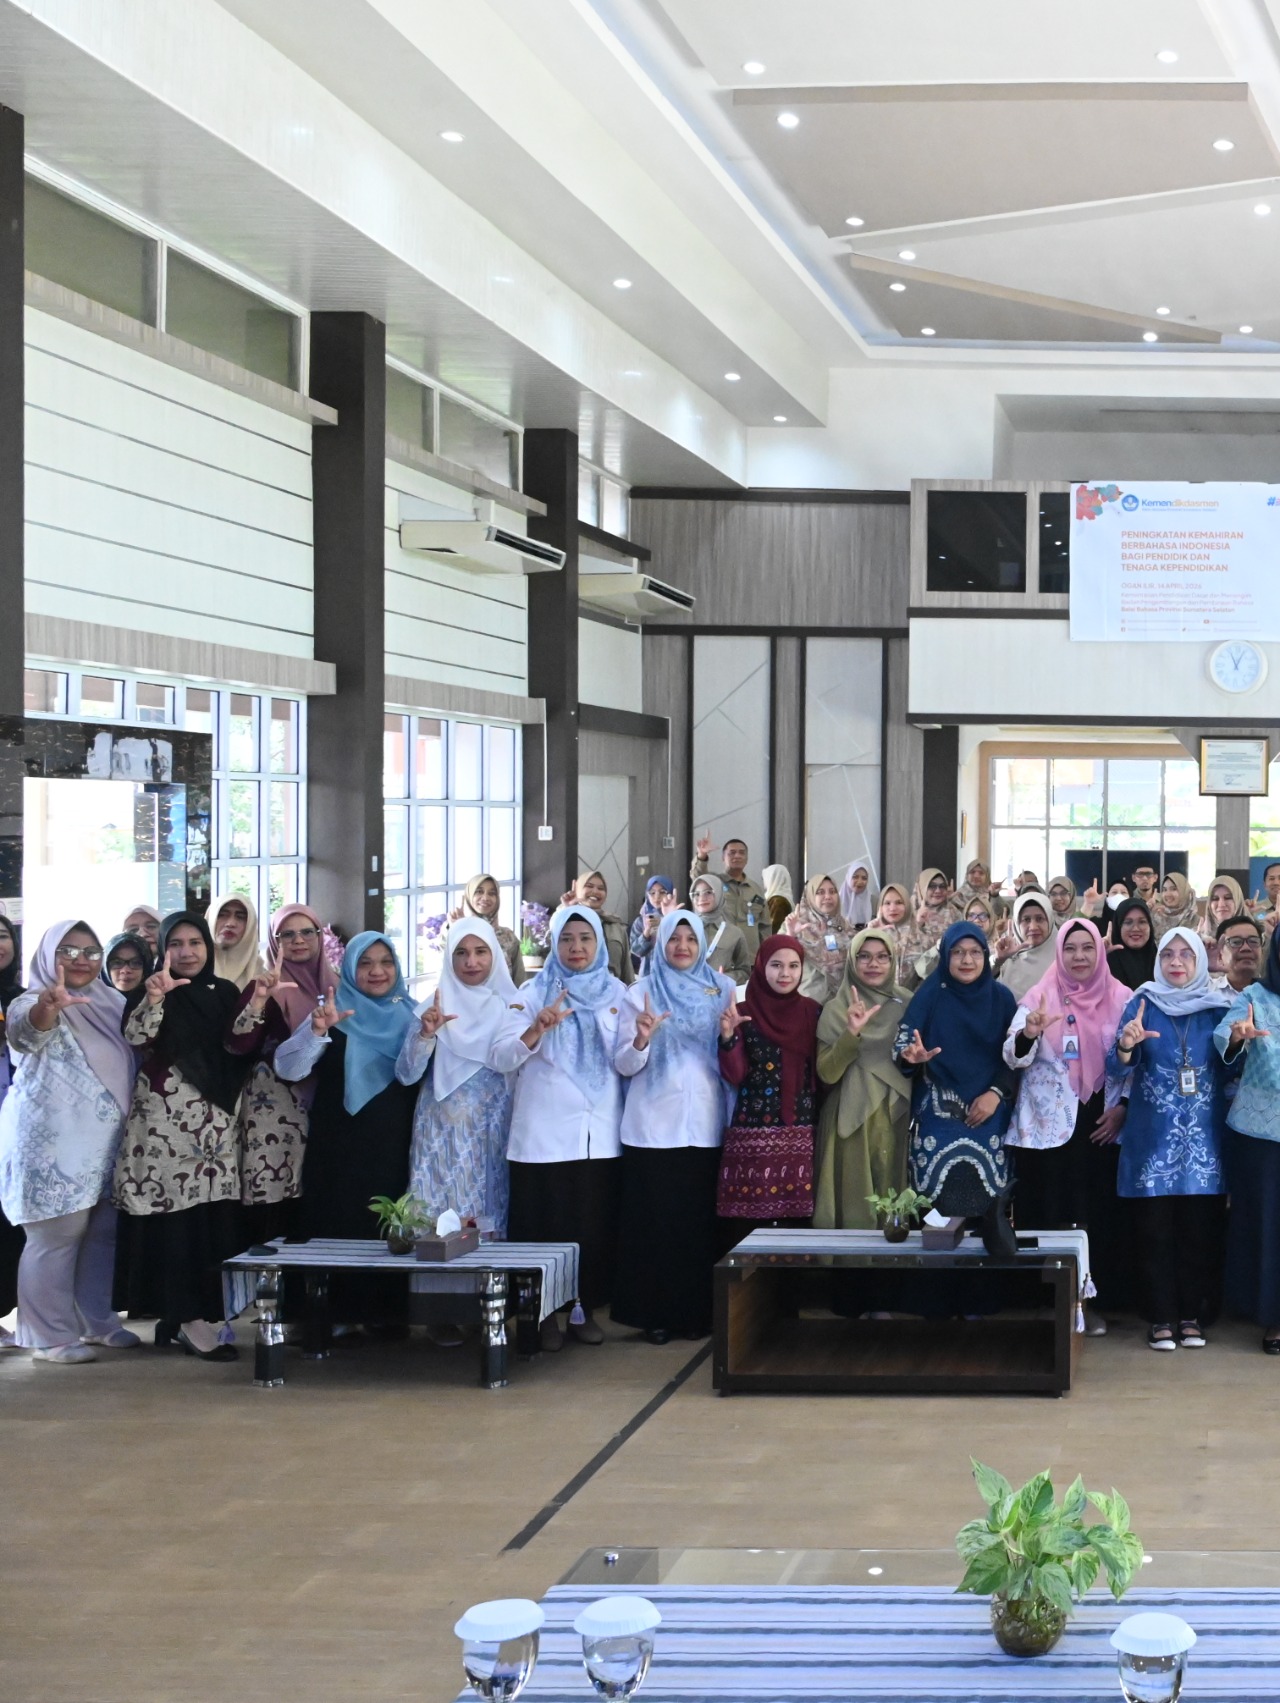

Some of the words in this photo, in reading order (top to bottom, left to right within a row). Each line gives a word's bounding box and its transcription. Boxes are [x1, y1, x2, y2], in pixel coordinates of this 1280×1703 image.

[1121, 531, 1186, 539] PENINGKATAN
[1188, 531, 1244, 539] KEMAHIRAN
[1121, 542, 1178, 550] BERBAHASA
[1179, 542, 1231, 550] INDONESIA
[1121, 553, 1144, 561] BAGI
[1145, 553, 1188, 561] PENDIDIK
[1190, 553, 1210, 561] DAN
[1121, 564, 1159, 572] TENAGA
[1160, 564, 1229, 572] KEPENDIDIKAN
